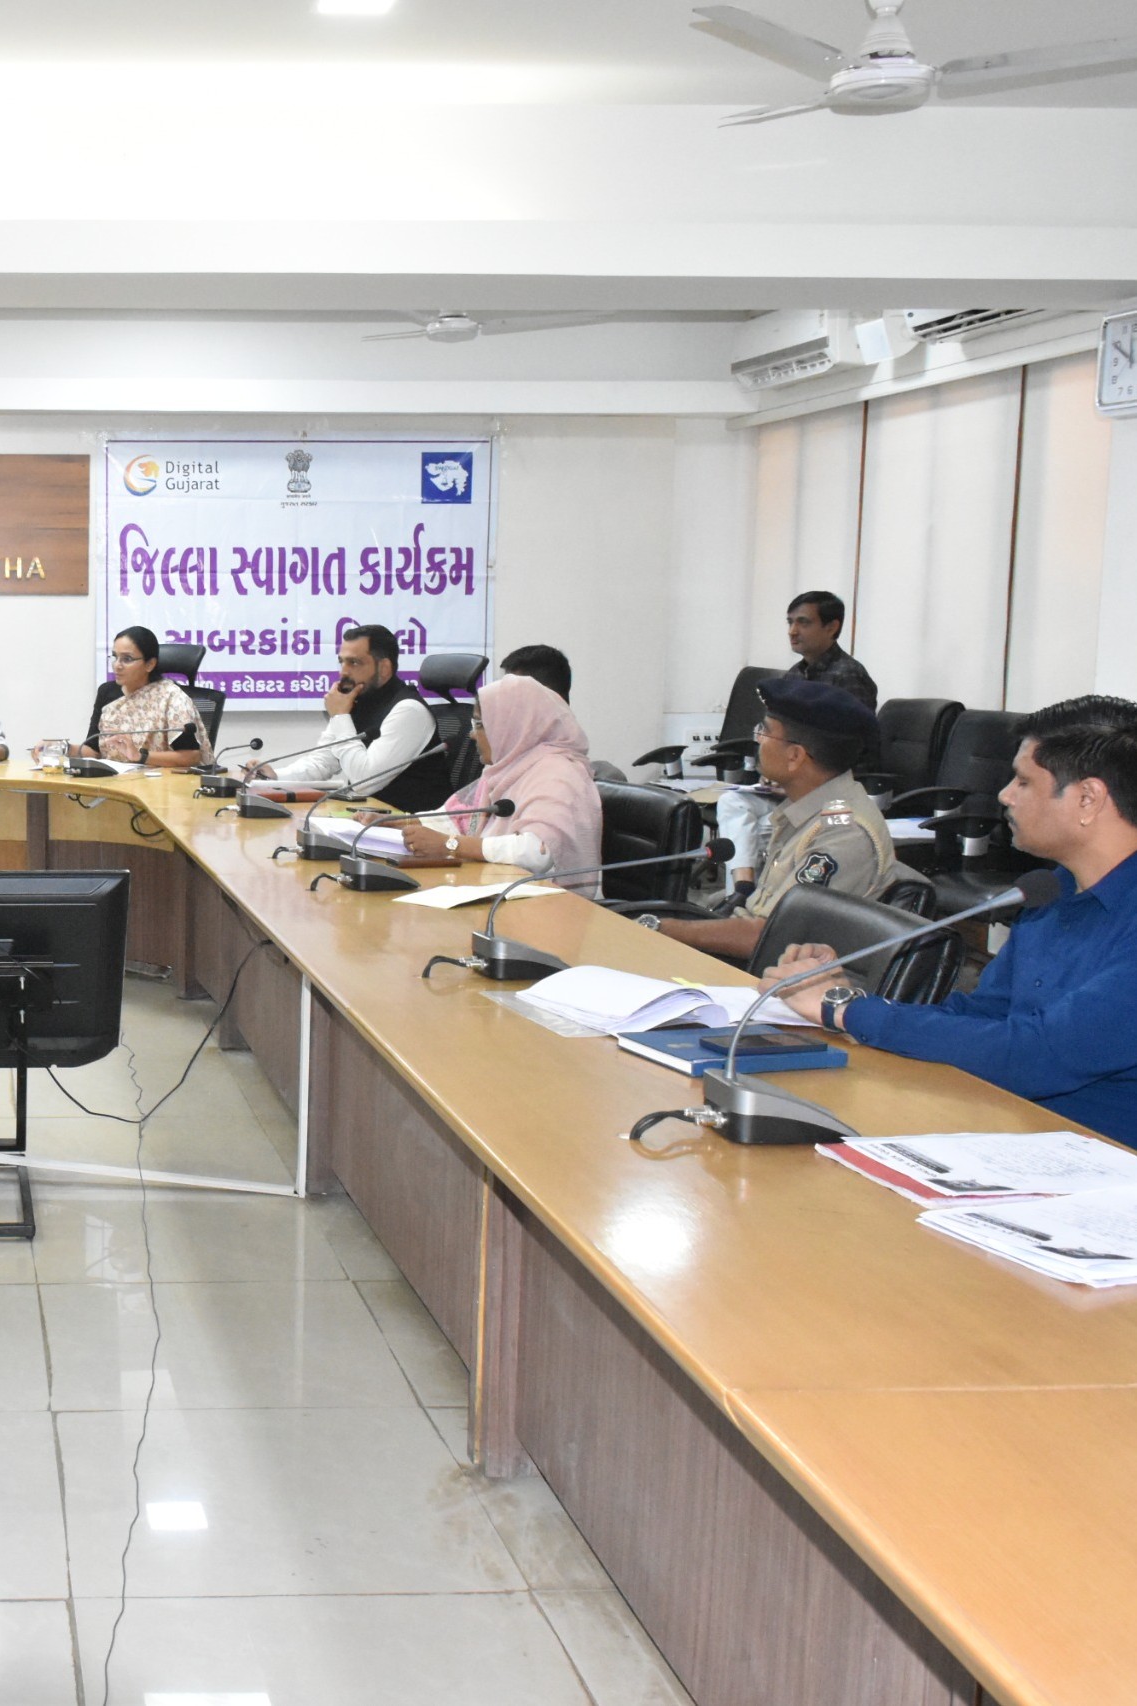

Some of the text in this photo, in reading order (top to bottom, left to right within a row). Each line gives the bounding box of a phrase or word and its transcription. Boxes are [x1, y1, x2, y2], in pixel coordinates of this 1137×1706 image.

[165, 460, 220, 477] Digital
[165, 477, 220, 493] Gujarat
[119, 522, 475, 596] જિલ્લા સ્વાગત કાર્યક્રમ
[290, 674, 330, 692] કચેરી
